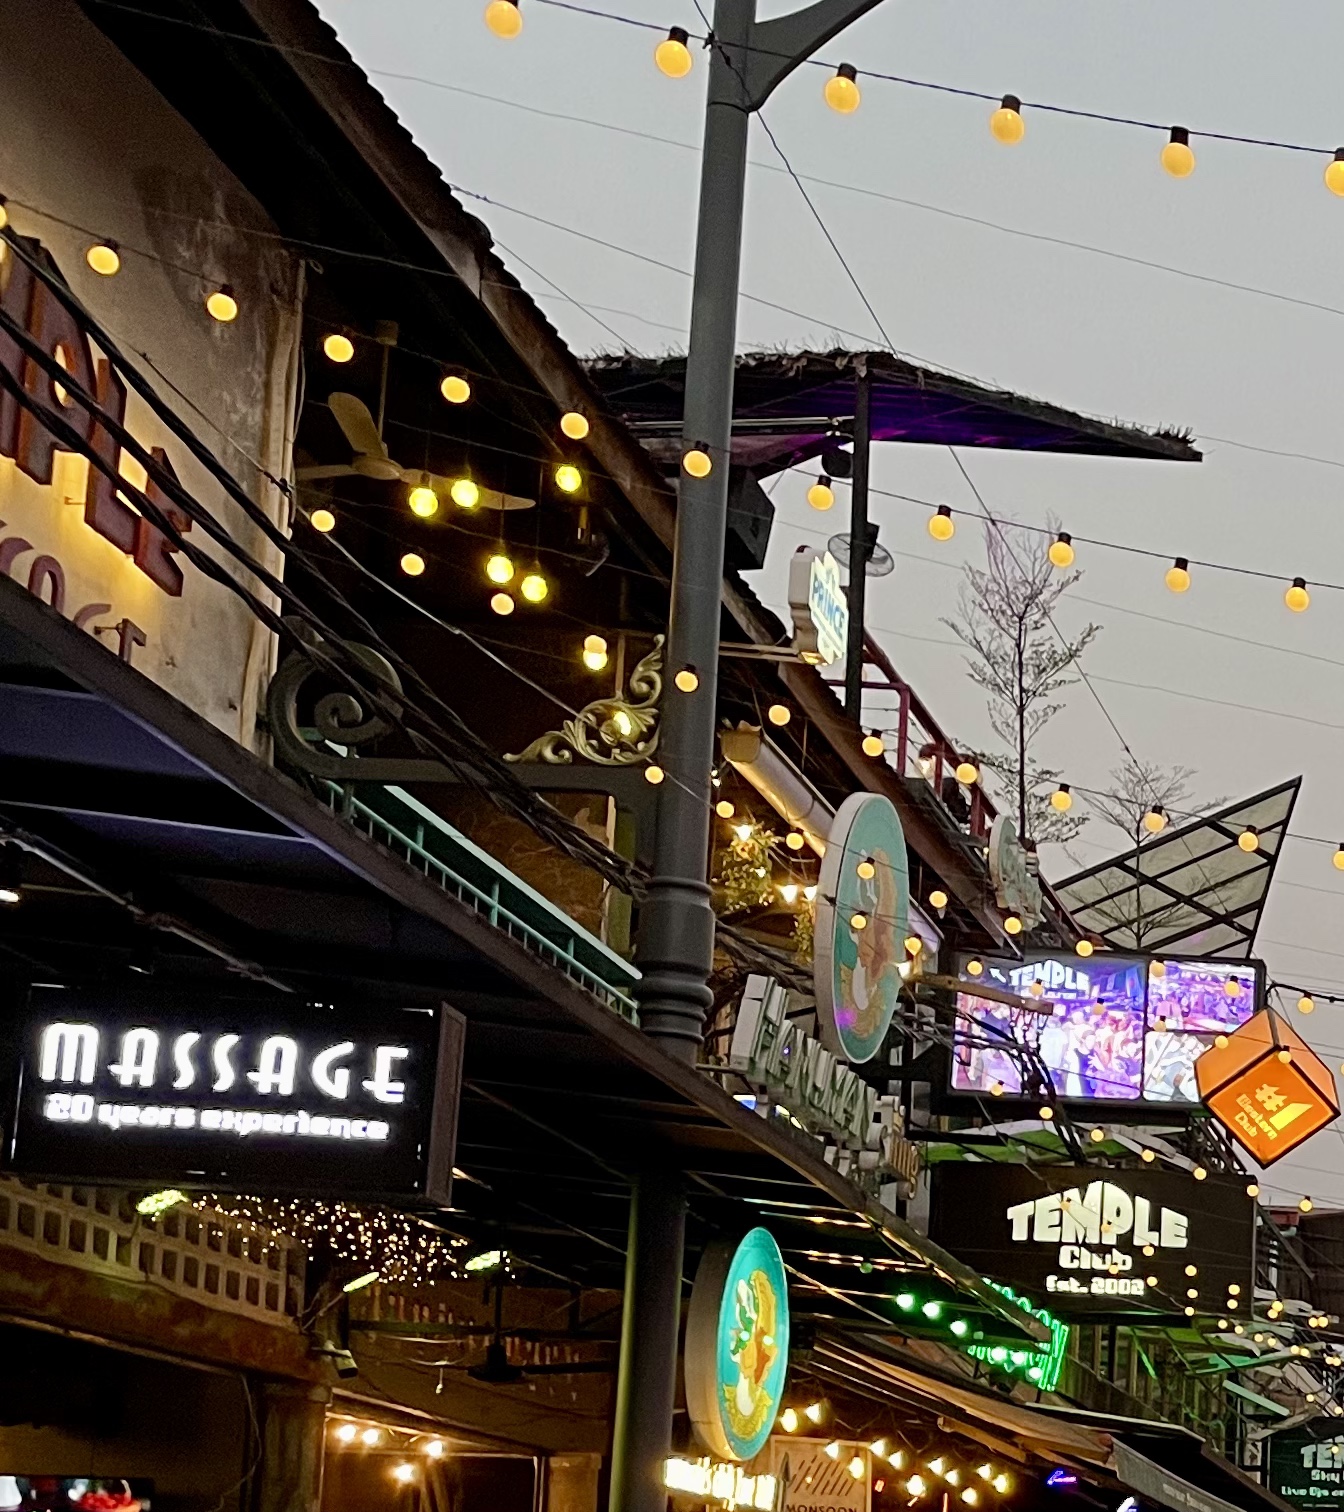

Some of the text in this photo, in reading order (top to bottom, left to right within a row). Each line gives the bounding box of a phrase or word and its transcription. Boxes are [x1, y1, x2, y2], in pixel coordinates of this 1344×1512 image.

[812, 573, 845, 641] PRINCE
[1008, 959, 1091, 990] TEMPLE
[40, 1021, 410, 1104] MASSAGE
[44, 1092, 391, 1140] 20 years experience
[1006, 1180, 1189, 1249] TEMPLE
[1058, 1245, 1133, 1271] Club
[1046, 1275, 1145, 1296] Est. 2002
[1281, 1485, 1307, 1496] Live
[1311, 1469, 1340, 1483] Sky
